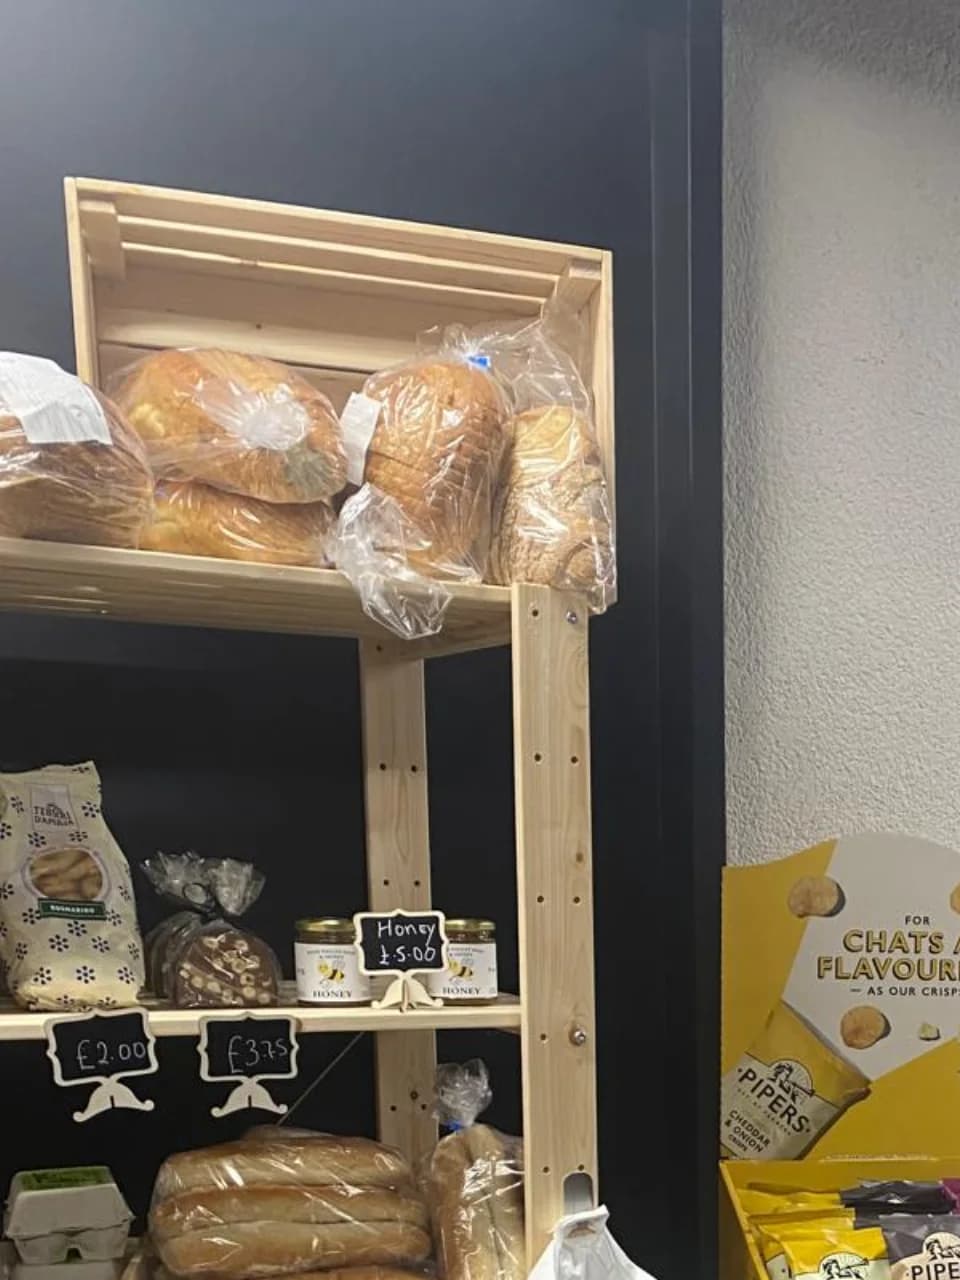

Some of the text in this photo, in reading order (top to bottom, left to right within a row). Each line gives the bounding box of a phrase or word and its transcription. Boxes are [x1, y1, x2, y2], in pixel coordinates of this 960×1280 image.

[377, 919, 436, 948] Honey
[905, 915, 930, 925] FOR
[843, 929, 945, 954] CHATS
[312, 990, 352, 998] HONEY
[442, 986, 482, 995] HONEY
[867, 986, 884, 996] AS
[889, 986, 916, 996] OUR
[77, 1039, 146, 1070] £2.00
[228, 1035, 288, 1074] £3.75
[738, 1067, 810, 1133] PIPERS
[729, 1109, 771, 1148] CHEDDAR
[733, 1125, 763, 1153] ONION
